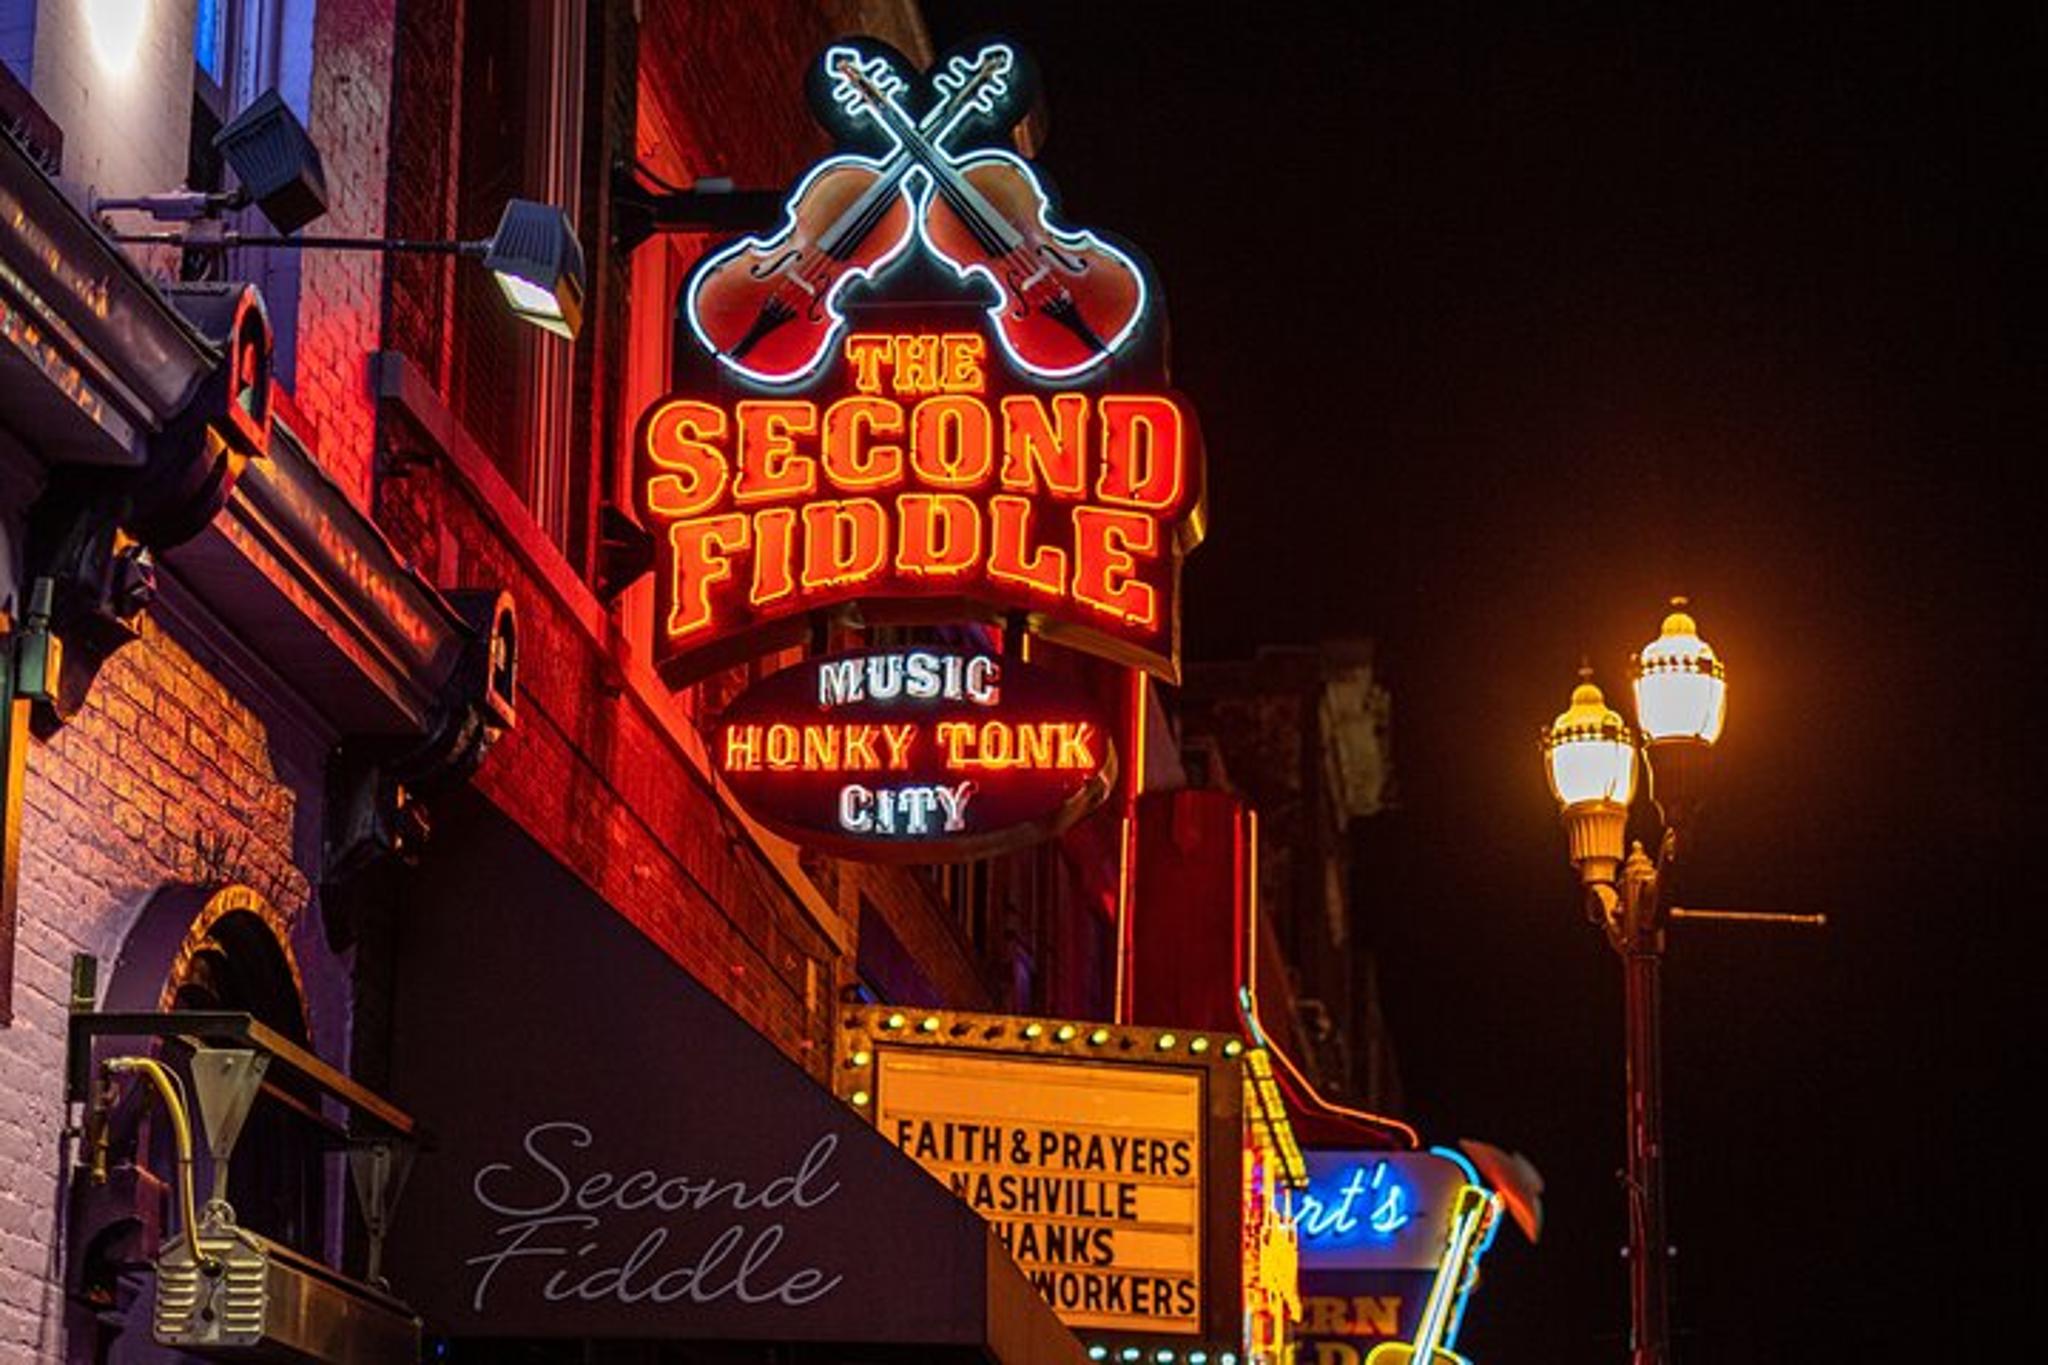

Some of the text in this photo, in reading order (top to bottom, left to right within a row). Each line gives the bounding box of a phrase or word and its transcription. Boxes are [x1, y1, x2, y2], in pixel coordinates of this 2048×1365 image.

[845, 333, 985, 393] THE
[647, 394, 1184, 510] SECOND
[667, 494, 1157, 636] FIDDLE
[818, 652, 1000, 708] MUSIC
[724, 721, 1096, 771] HONKY TONK
[838, 782, 975, 834] CITY
[474, 1121, 840, 1216] Second
[898, 1119, 1192, 1177] FAITH & PRAYERS
[950, 1171, 1137, 1221] NASHVILLE
[465, 1215, 843, 1310] Fiddle
[986, 1221, 1114, 1266] HANKS
[1029, 1270, 1197, 1316] WORKERS
